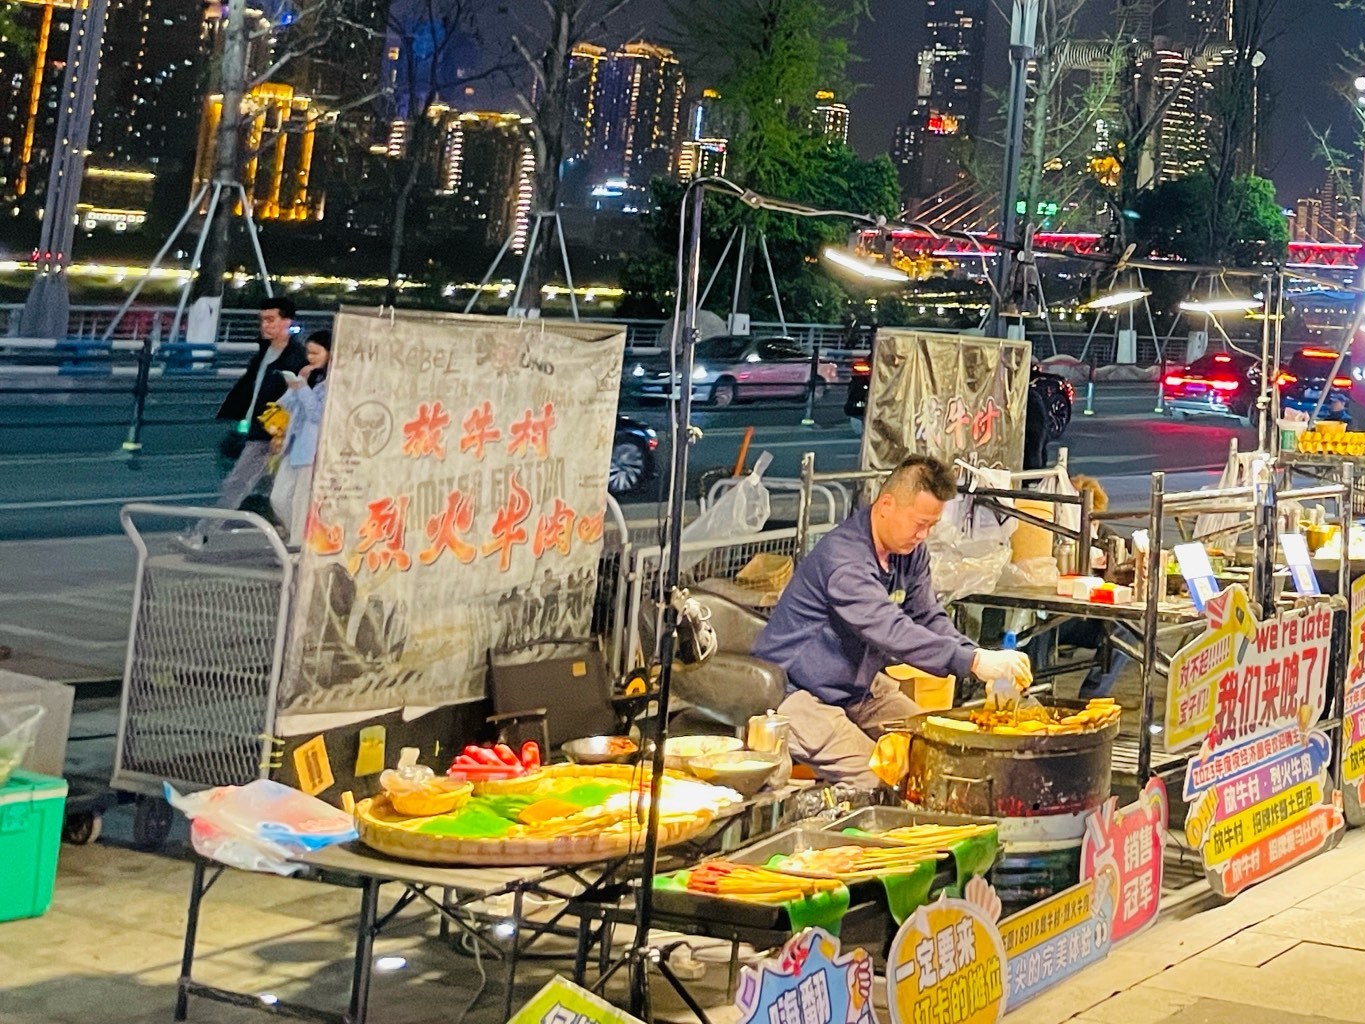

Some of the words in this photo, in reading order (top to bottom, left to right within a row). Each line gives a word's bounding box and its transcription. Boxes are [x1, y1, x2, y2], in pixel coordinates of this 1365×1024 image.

[357, 466, 577, 572] 烈火牛肉
[1124, 824, 1153, 874] 销售
[1123, 871, 1153, 921] 冠军
[895, 916, 977, 993] 一定要来
